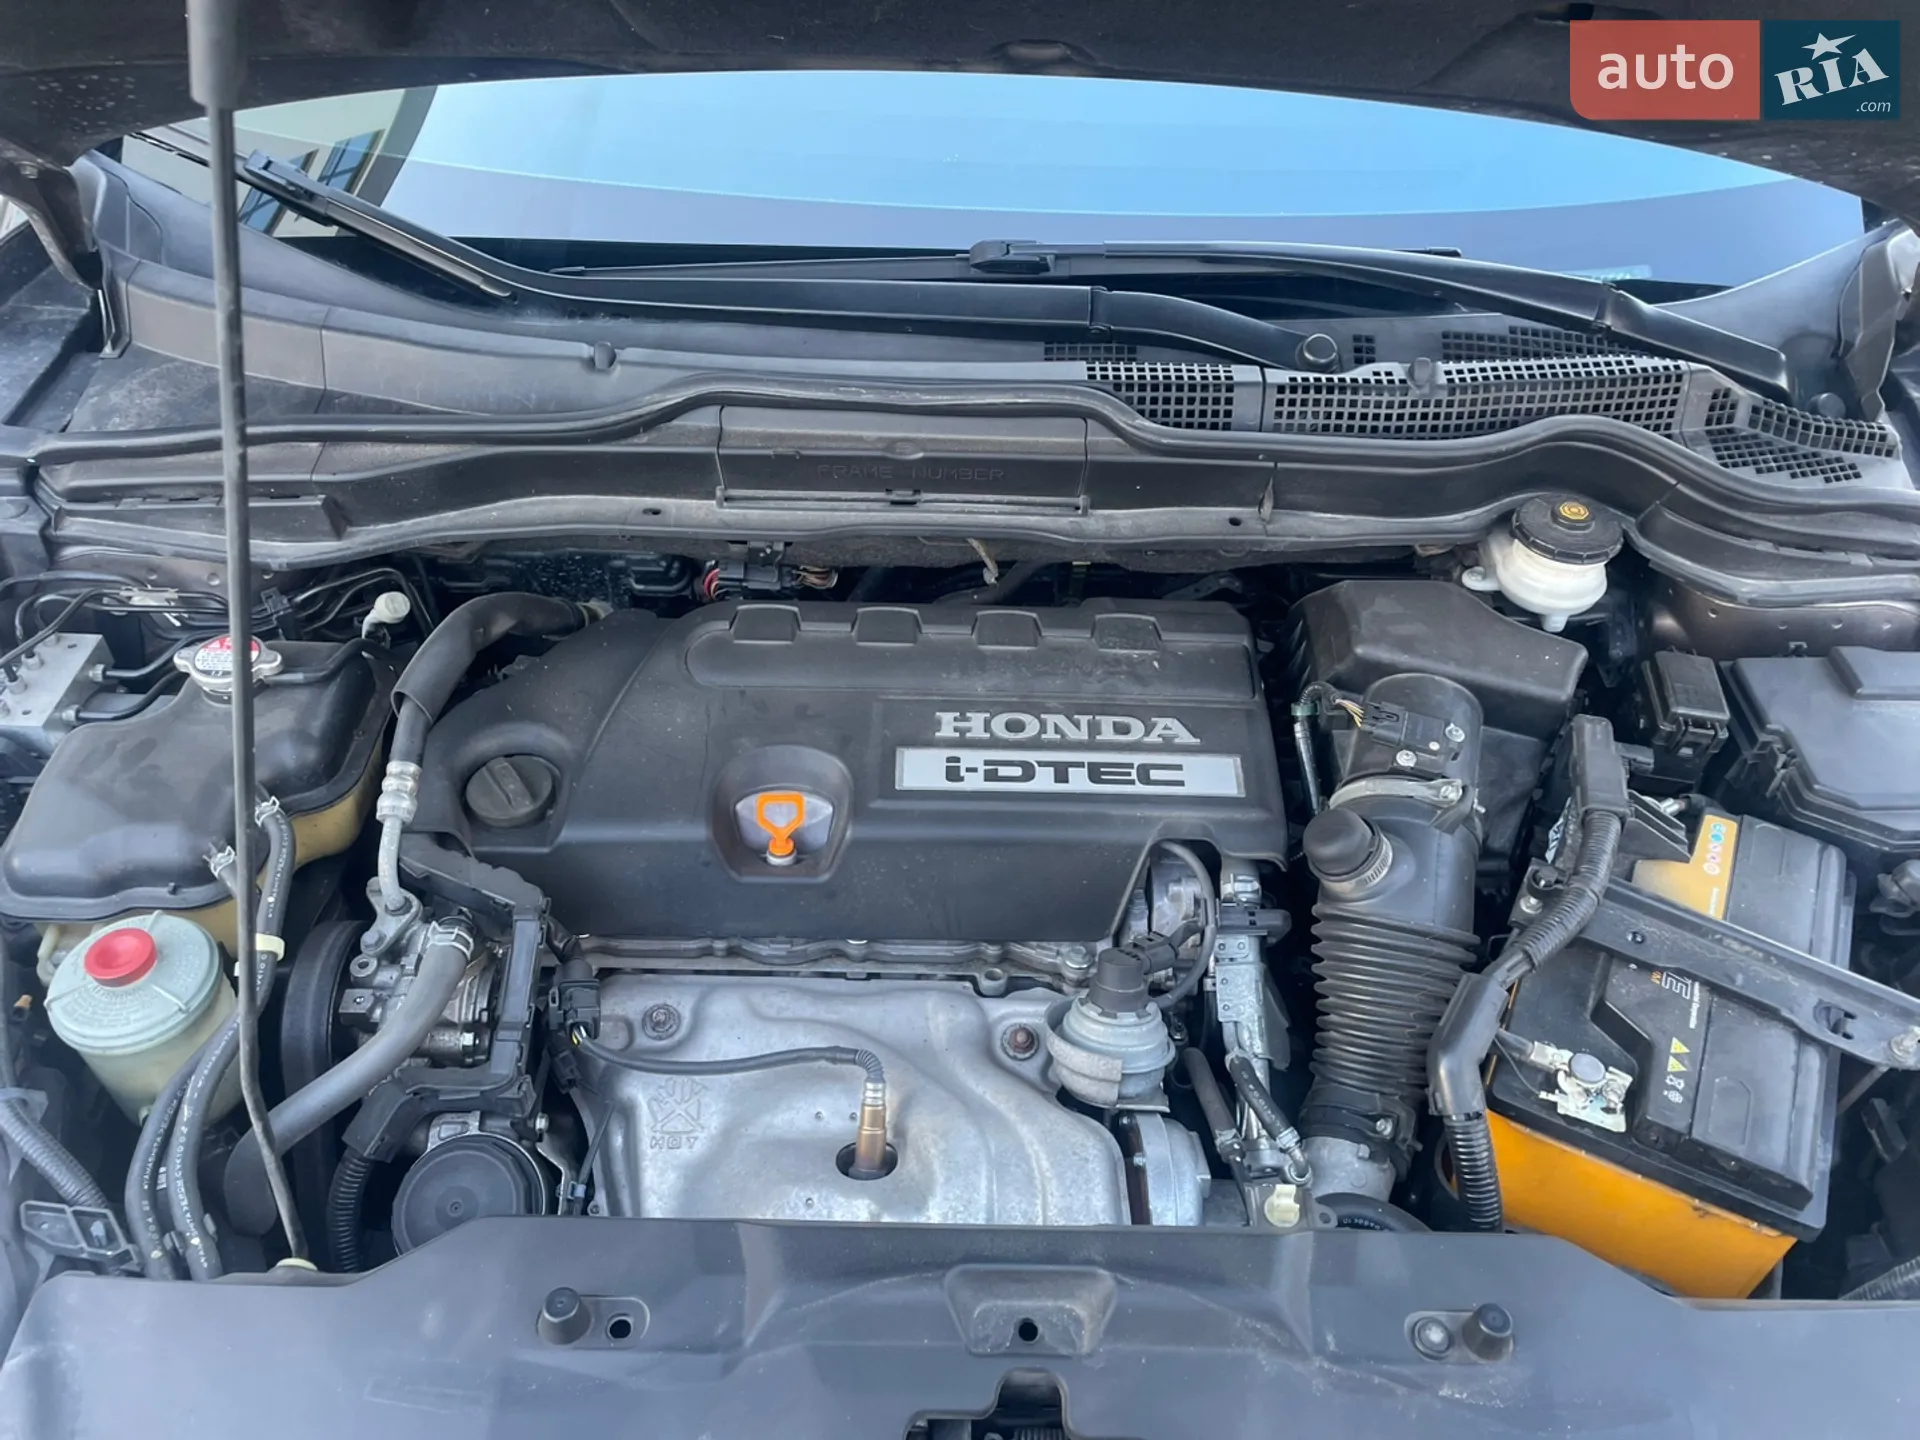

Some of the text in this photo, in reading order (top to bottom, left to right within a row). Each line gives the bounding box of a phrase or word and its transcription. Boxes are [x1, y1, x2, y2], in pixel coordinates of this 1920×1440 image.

[817, 464, 1004, 481] FRAME NUMBER
[935, 711, 1201, 744] HONDA
[945, 756, 1186, 788] i-DTEC
